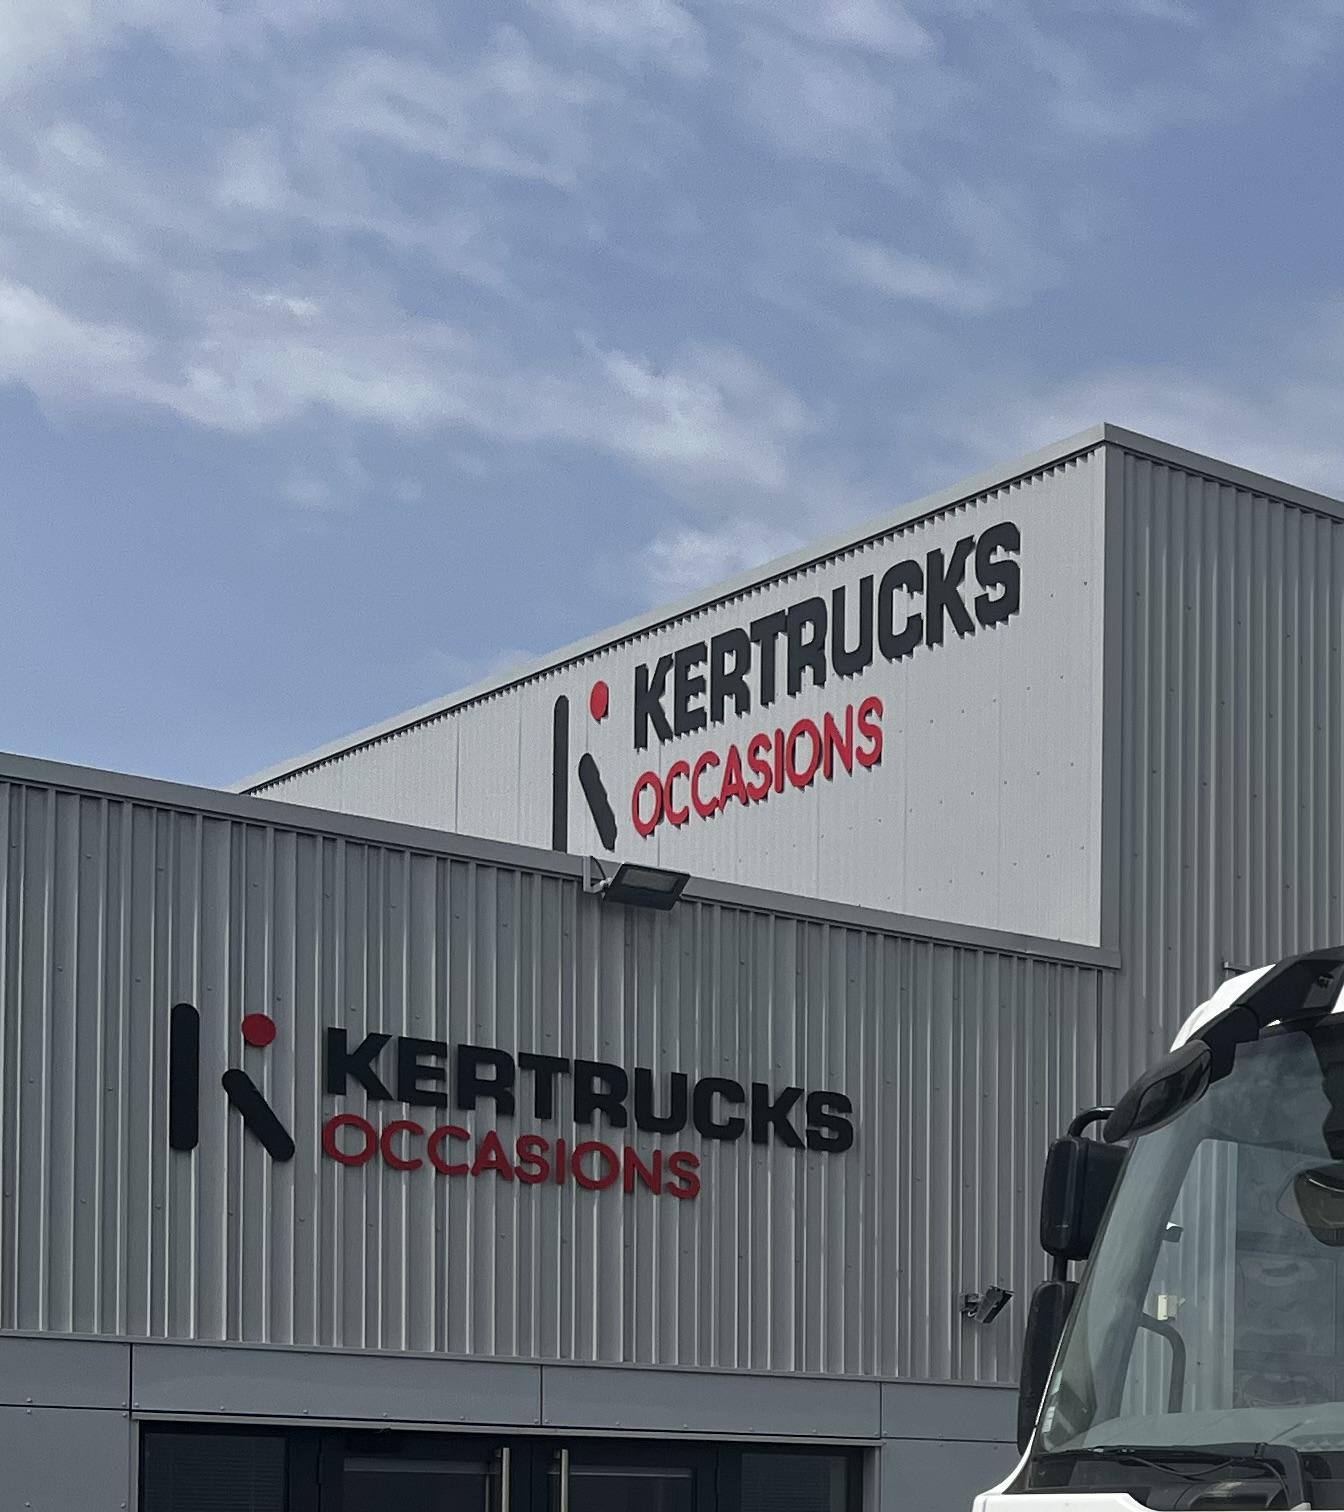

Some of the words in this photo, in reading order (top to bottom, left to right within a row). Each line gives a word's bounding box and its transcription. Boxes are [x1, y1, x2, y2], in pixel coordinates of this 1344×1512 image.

[634, 520, 1020, 750] KERTRUCKS
[631, 696, 885, 838] OCCASIONS
[321, 1113, 702, 1201] OCCASIONS
[326, 1027, 855, 1154] KERTRUCKS
